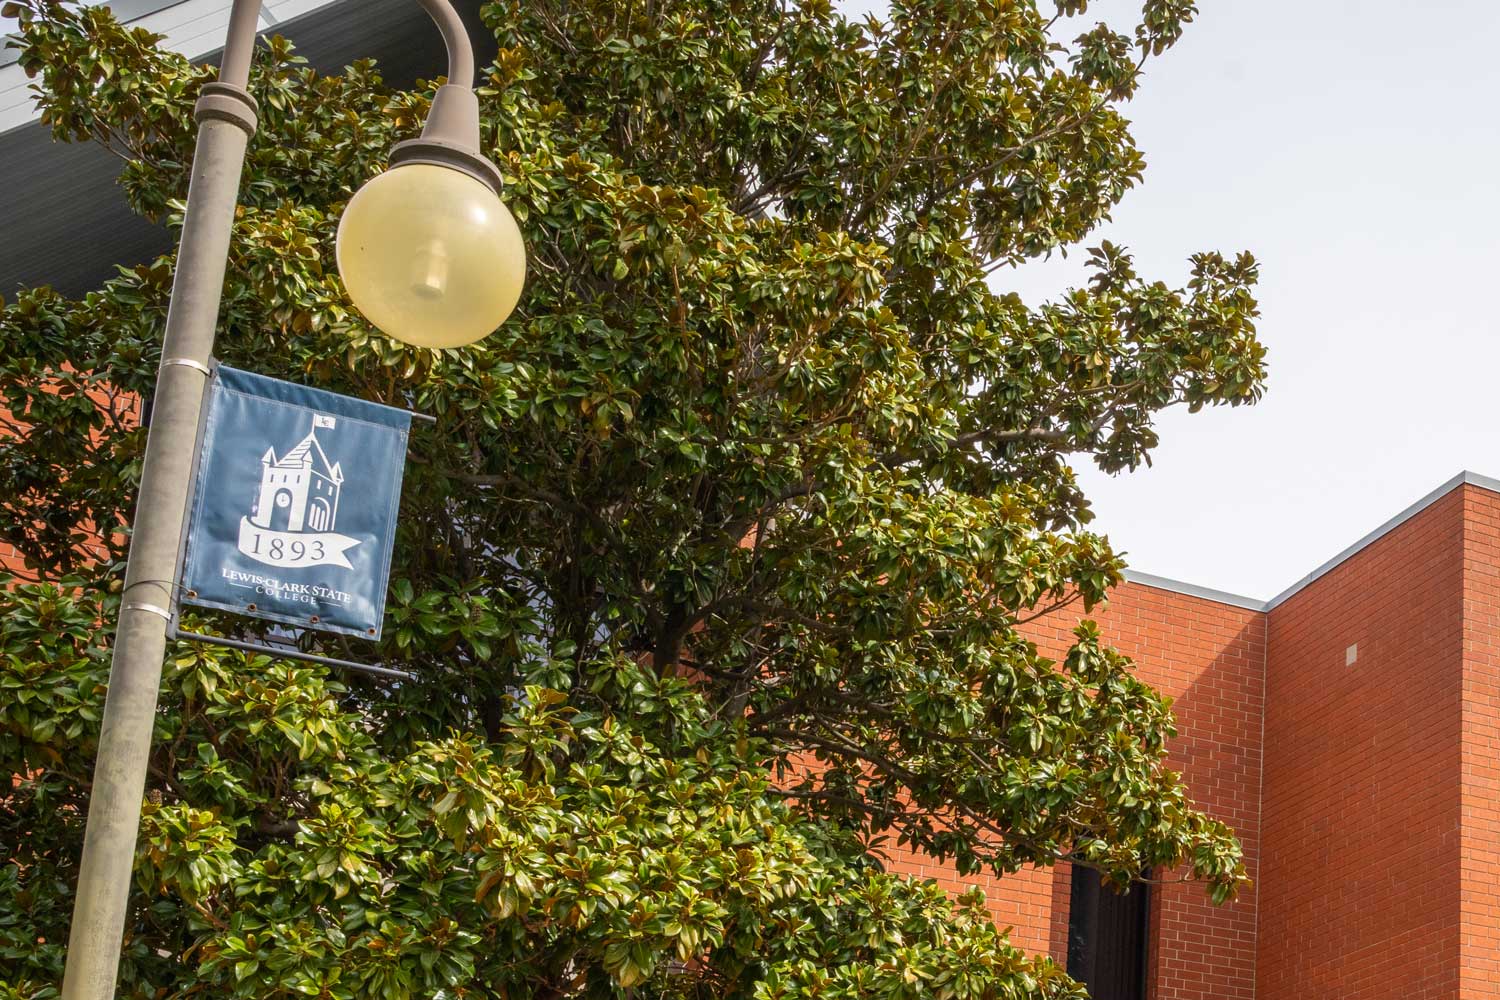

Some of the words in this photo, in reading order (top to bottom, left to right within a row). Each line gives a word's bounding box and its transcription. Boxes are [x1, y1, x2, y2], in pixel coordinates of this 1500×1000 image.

[252, 533, 326, 562] 1893
[221, 567, 311, 595] LEWIS-CLARK
[311, 585, 352, 603] STATE
[255, 585, 317, 605] COLLEGE
